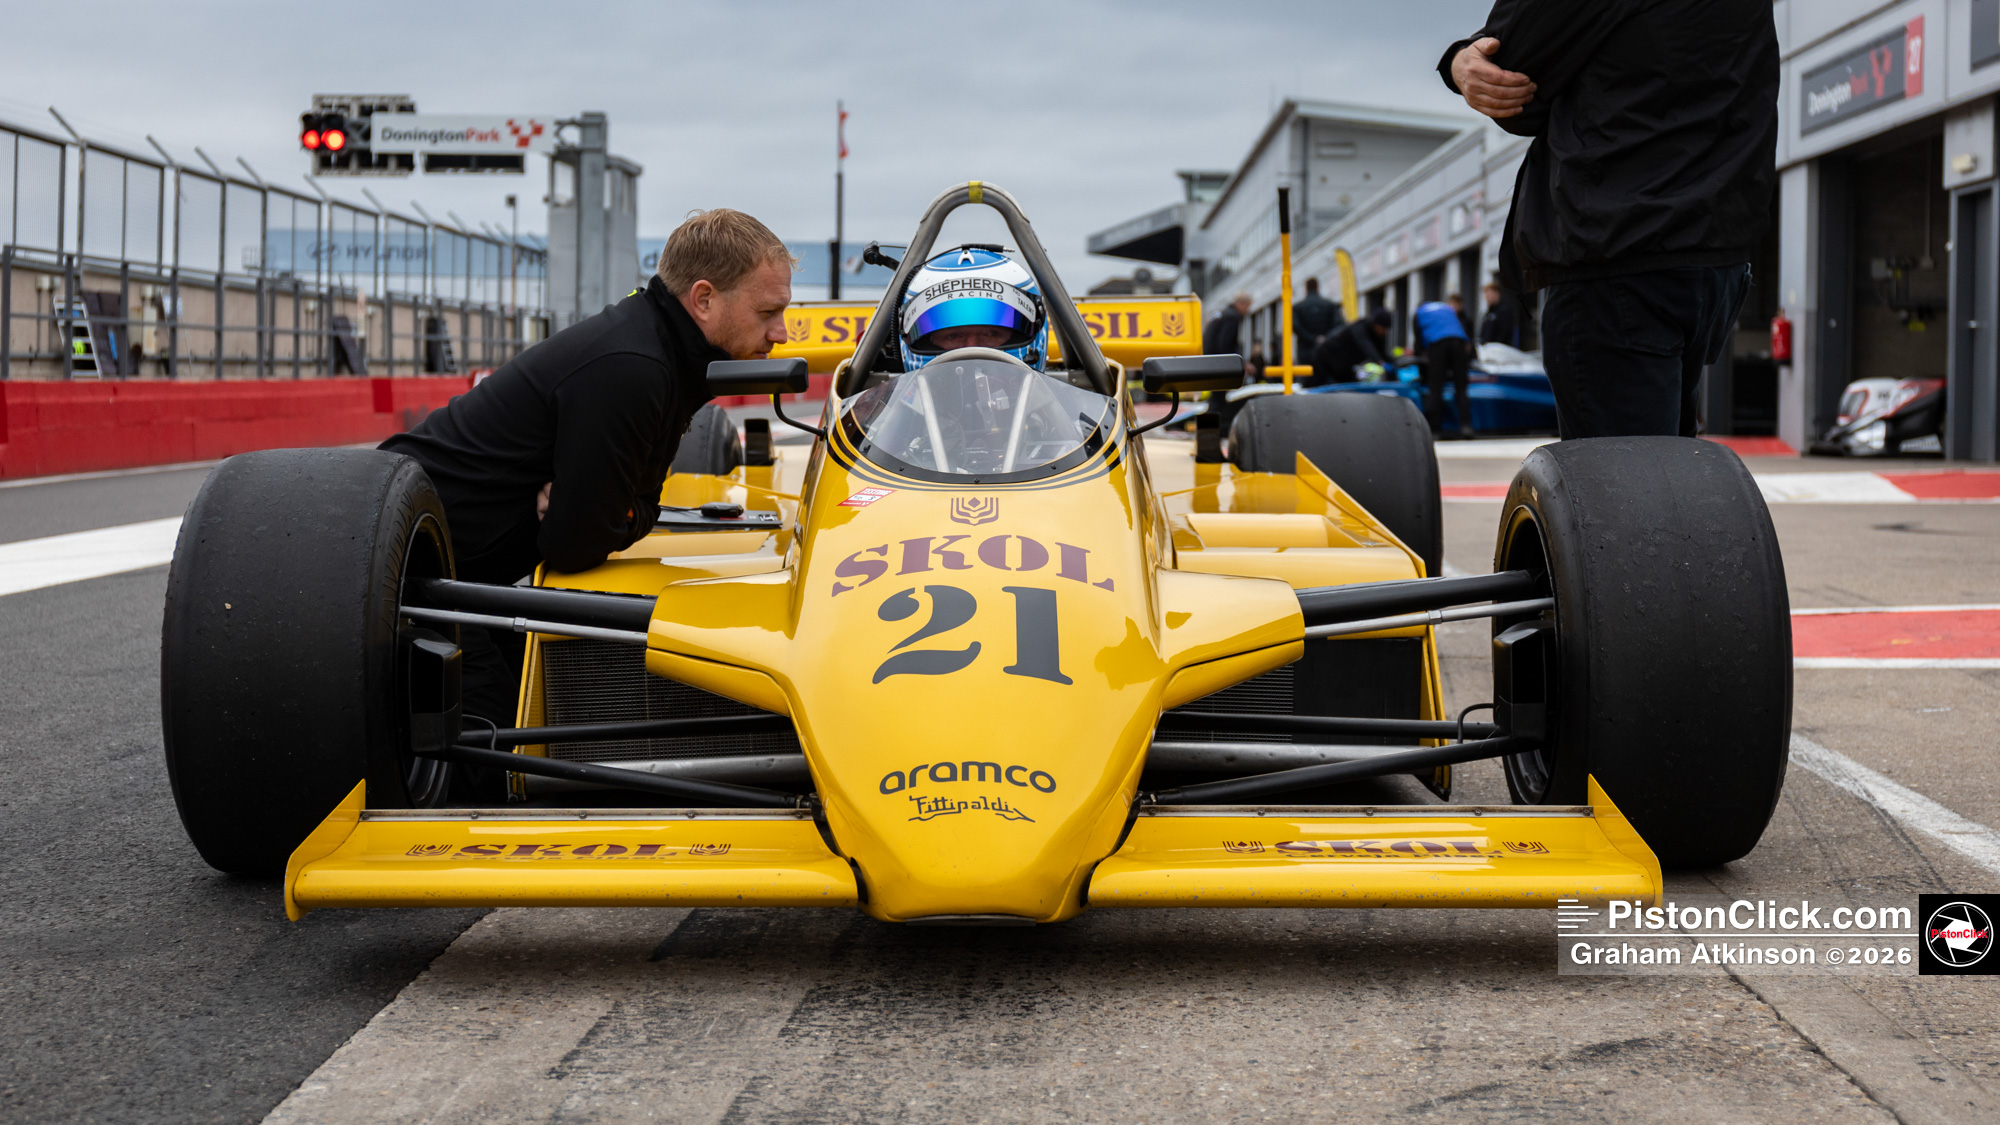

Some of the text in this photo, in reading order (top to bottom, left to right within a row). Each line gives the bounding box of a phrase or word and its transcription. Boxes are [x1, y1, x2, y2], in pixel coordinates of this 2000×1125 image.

[1908, 35, 1922, 75] 27
[381, 127, 500, 145] DoningtonPark
[924, 279, 1004, 300] SHEPHERD
[947, 290, 1004, 301] RACING
[1081, 312, 1153, 339] SIL
[831, 534, 1115, 597] SKOL
[872, 584, 1073, 686] 21
[879, 761, 1057, 795] aramco
[908, 795, 1018, 817] Fittipaldi
[452, 844, 677, 856] SKOL
[1274, 841, 1503, 854] SKOL
